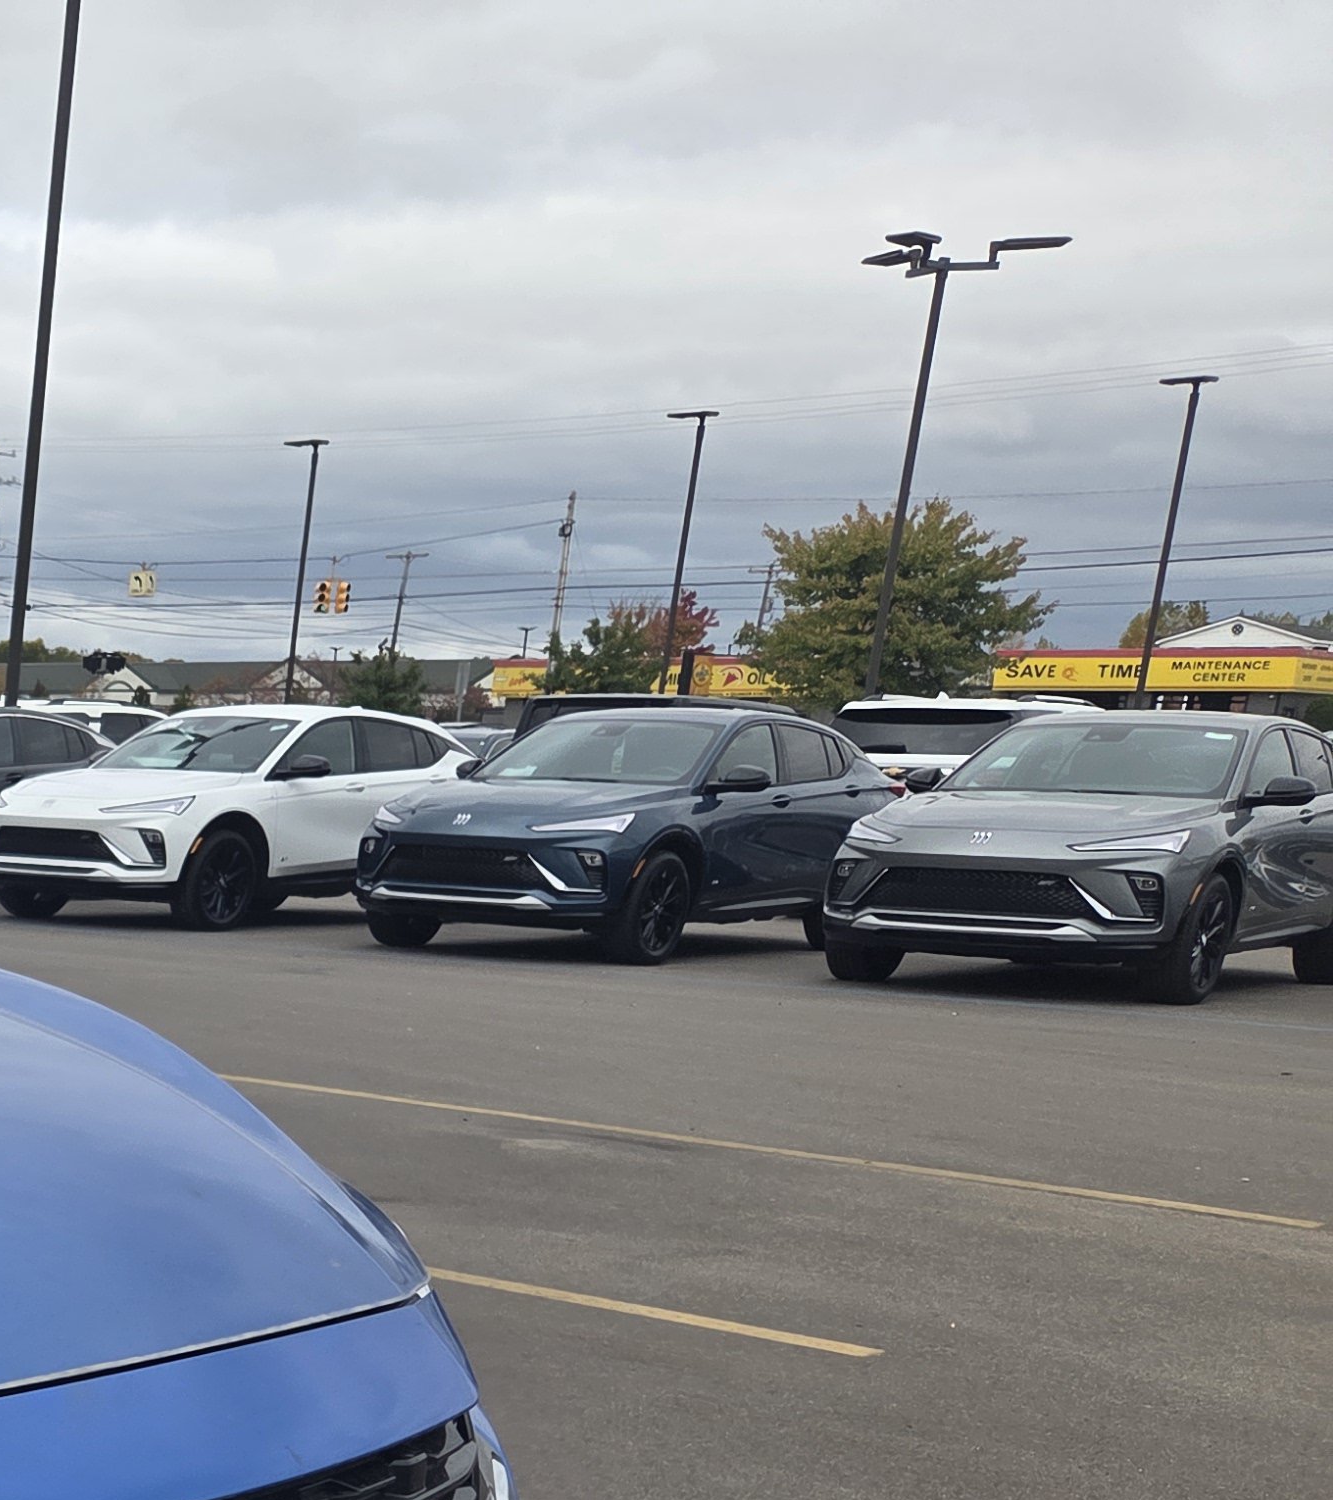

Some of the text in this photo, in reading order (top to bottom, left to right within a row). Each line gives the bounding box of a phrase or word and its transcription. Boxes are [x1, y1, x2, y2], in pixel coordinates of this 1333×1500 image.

[1005, 663, 1143, 678] SAVE TIME
[1171, 660, 1271, 671] MAINTENANCE
[747, 671, 770, 685] OIL
[1192, 672, 1246, 682] CENTER
